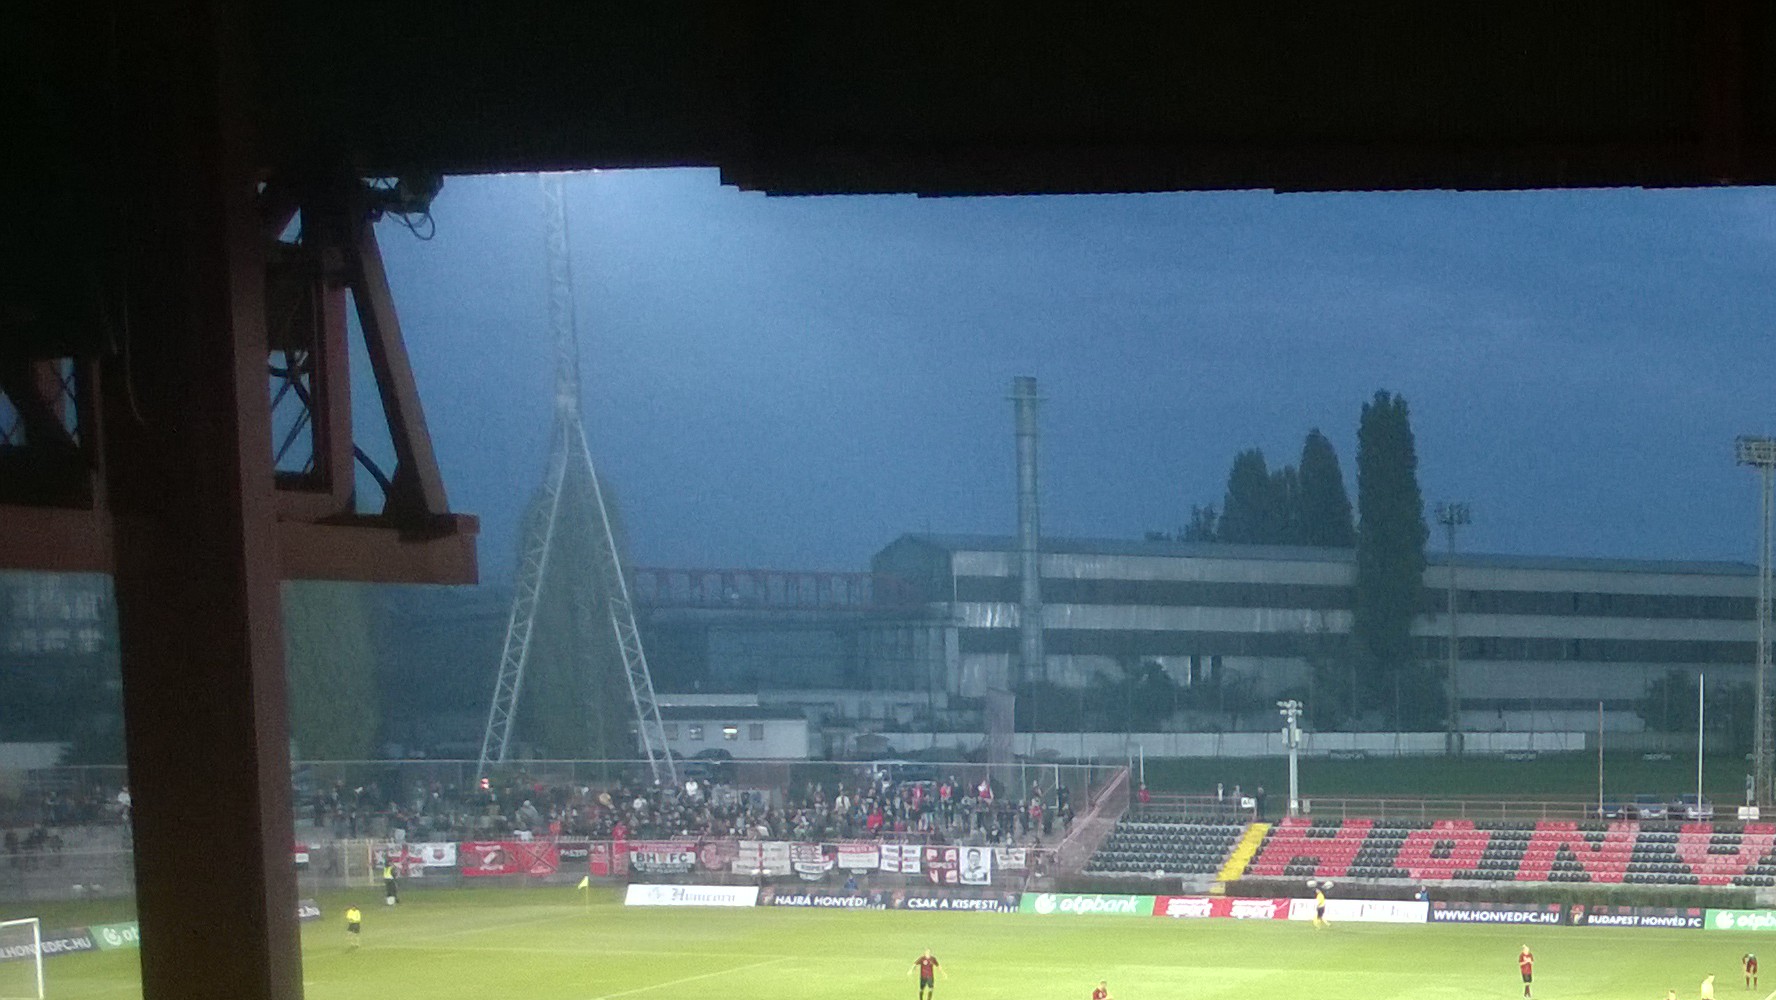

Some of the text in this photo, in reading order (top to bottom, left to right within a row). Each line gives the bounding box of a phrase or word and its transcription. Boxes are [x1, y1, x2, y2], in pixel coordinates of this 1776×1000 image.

[907, 898, 938, 909] CSAK
[940, 898, 949, 909] A
[1059, 895, 1140, 914] otpbank
[1433, 909, 1560, 923] WWW.HONVEDFC.HU
[1587, 914, 1639, 925] BUDAPEST
[1687, 917, 1702, 927] FC
